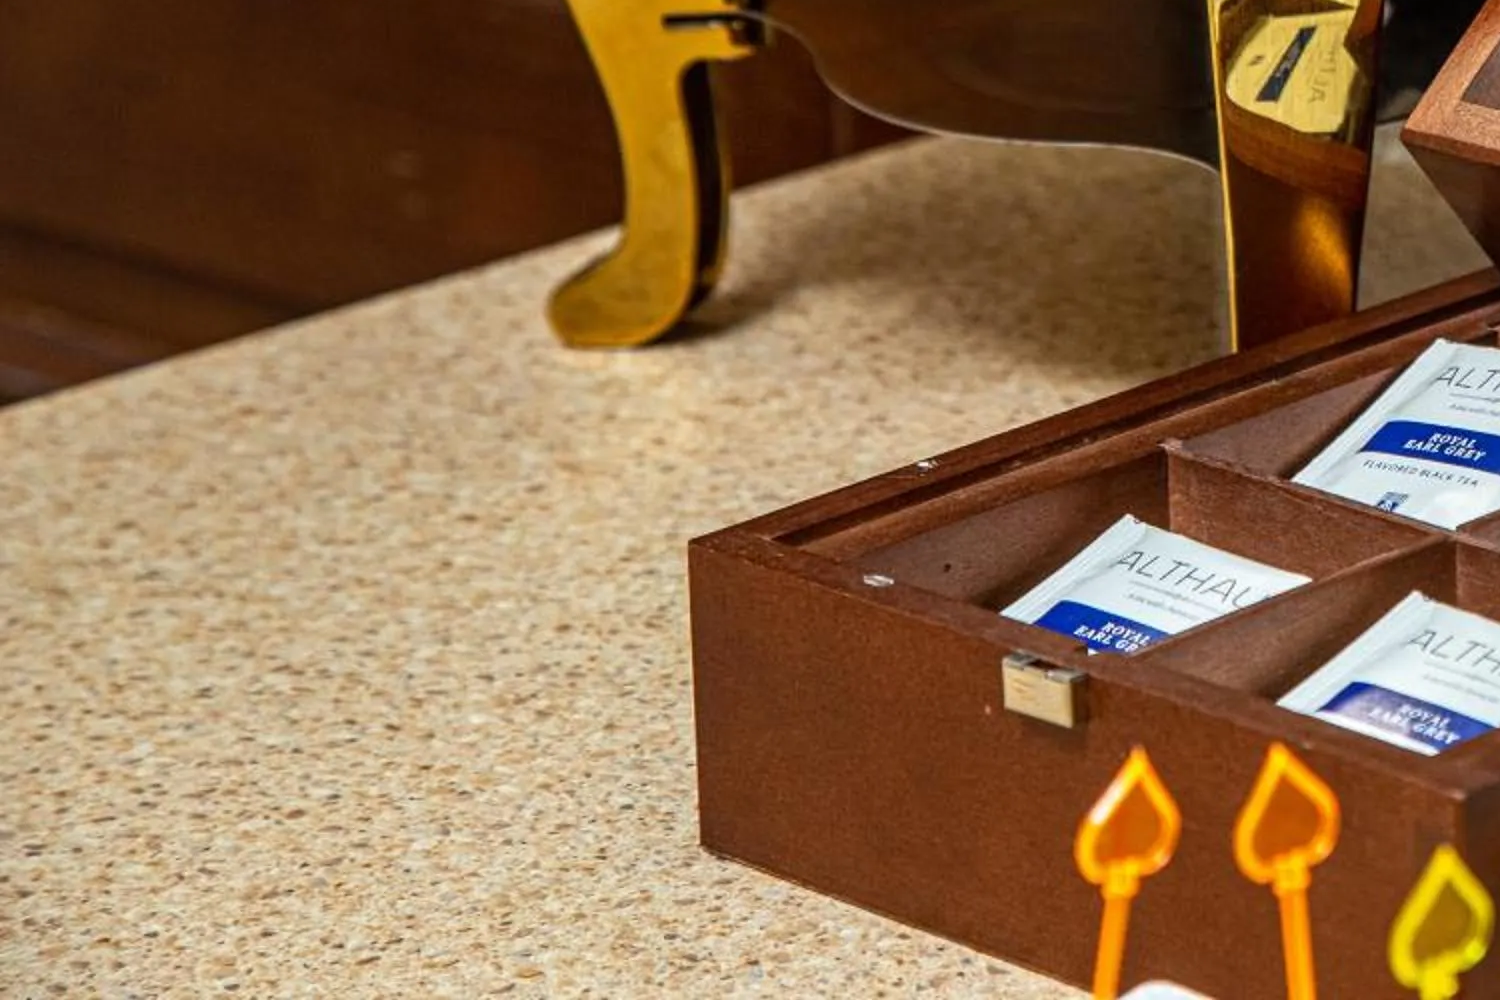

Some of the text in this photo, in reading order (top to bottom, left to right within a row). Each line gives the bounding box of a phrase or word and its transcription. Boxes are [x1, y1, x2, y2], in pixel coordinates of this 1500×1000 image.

[1403, 439, 1488, 462] EARL GREY
[1428, 432, 1478, 448] ROYAL
[1363, 459, 1480, 488] FLAVORED BLACK TEA
[1073, 624, 1139, 653] EARL GR
[1101, 621, 1151, 647] ROYAL
[1399, 704, 1451, 729] ROYAL
[1412, 723, 1461, 745] GREY
